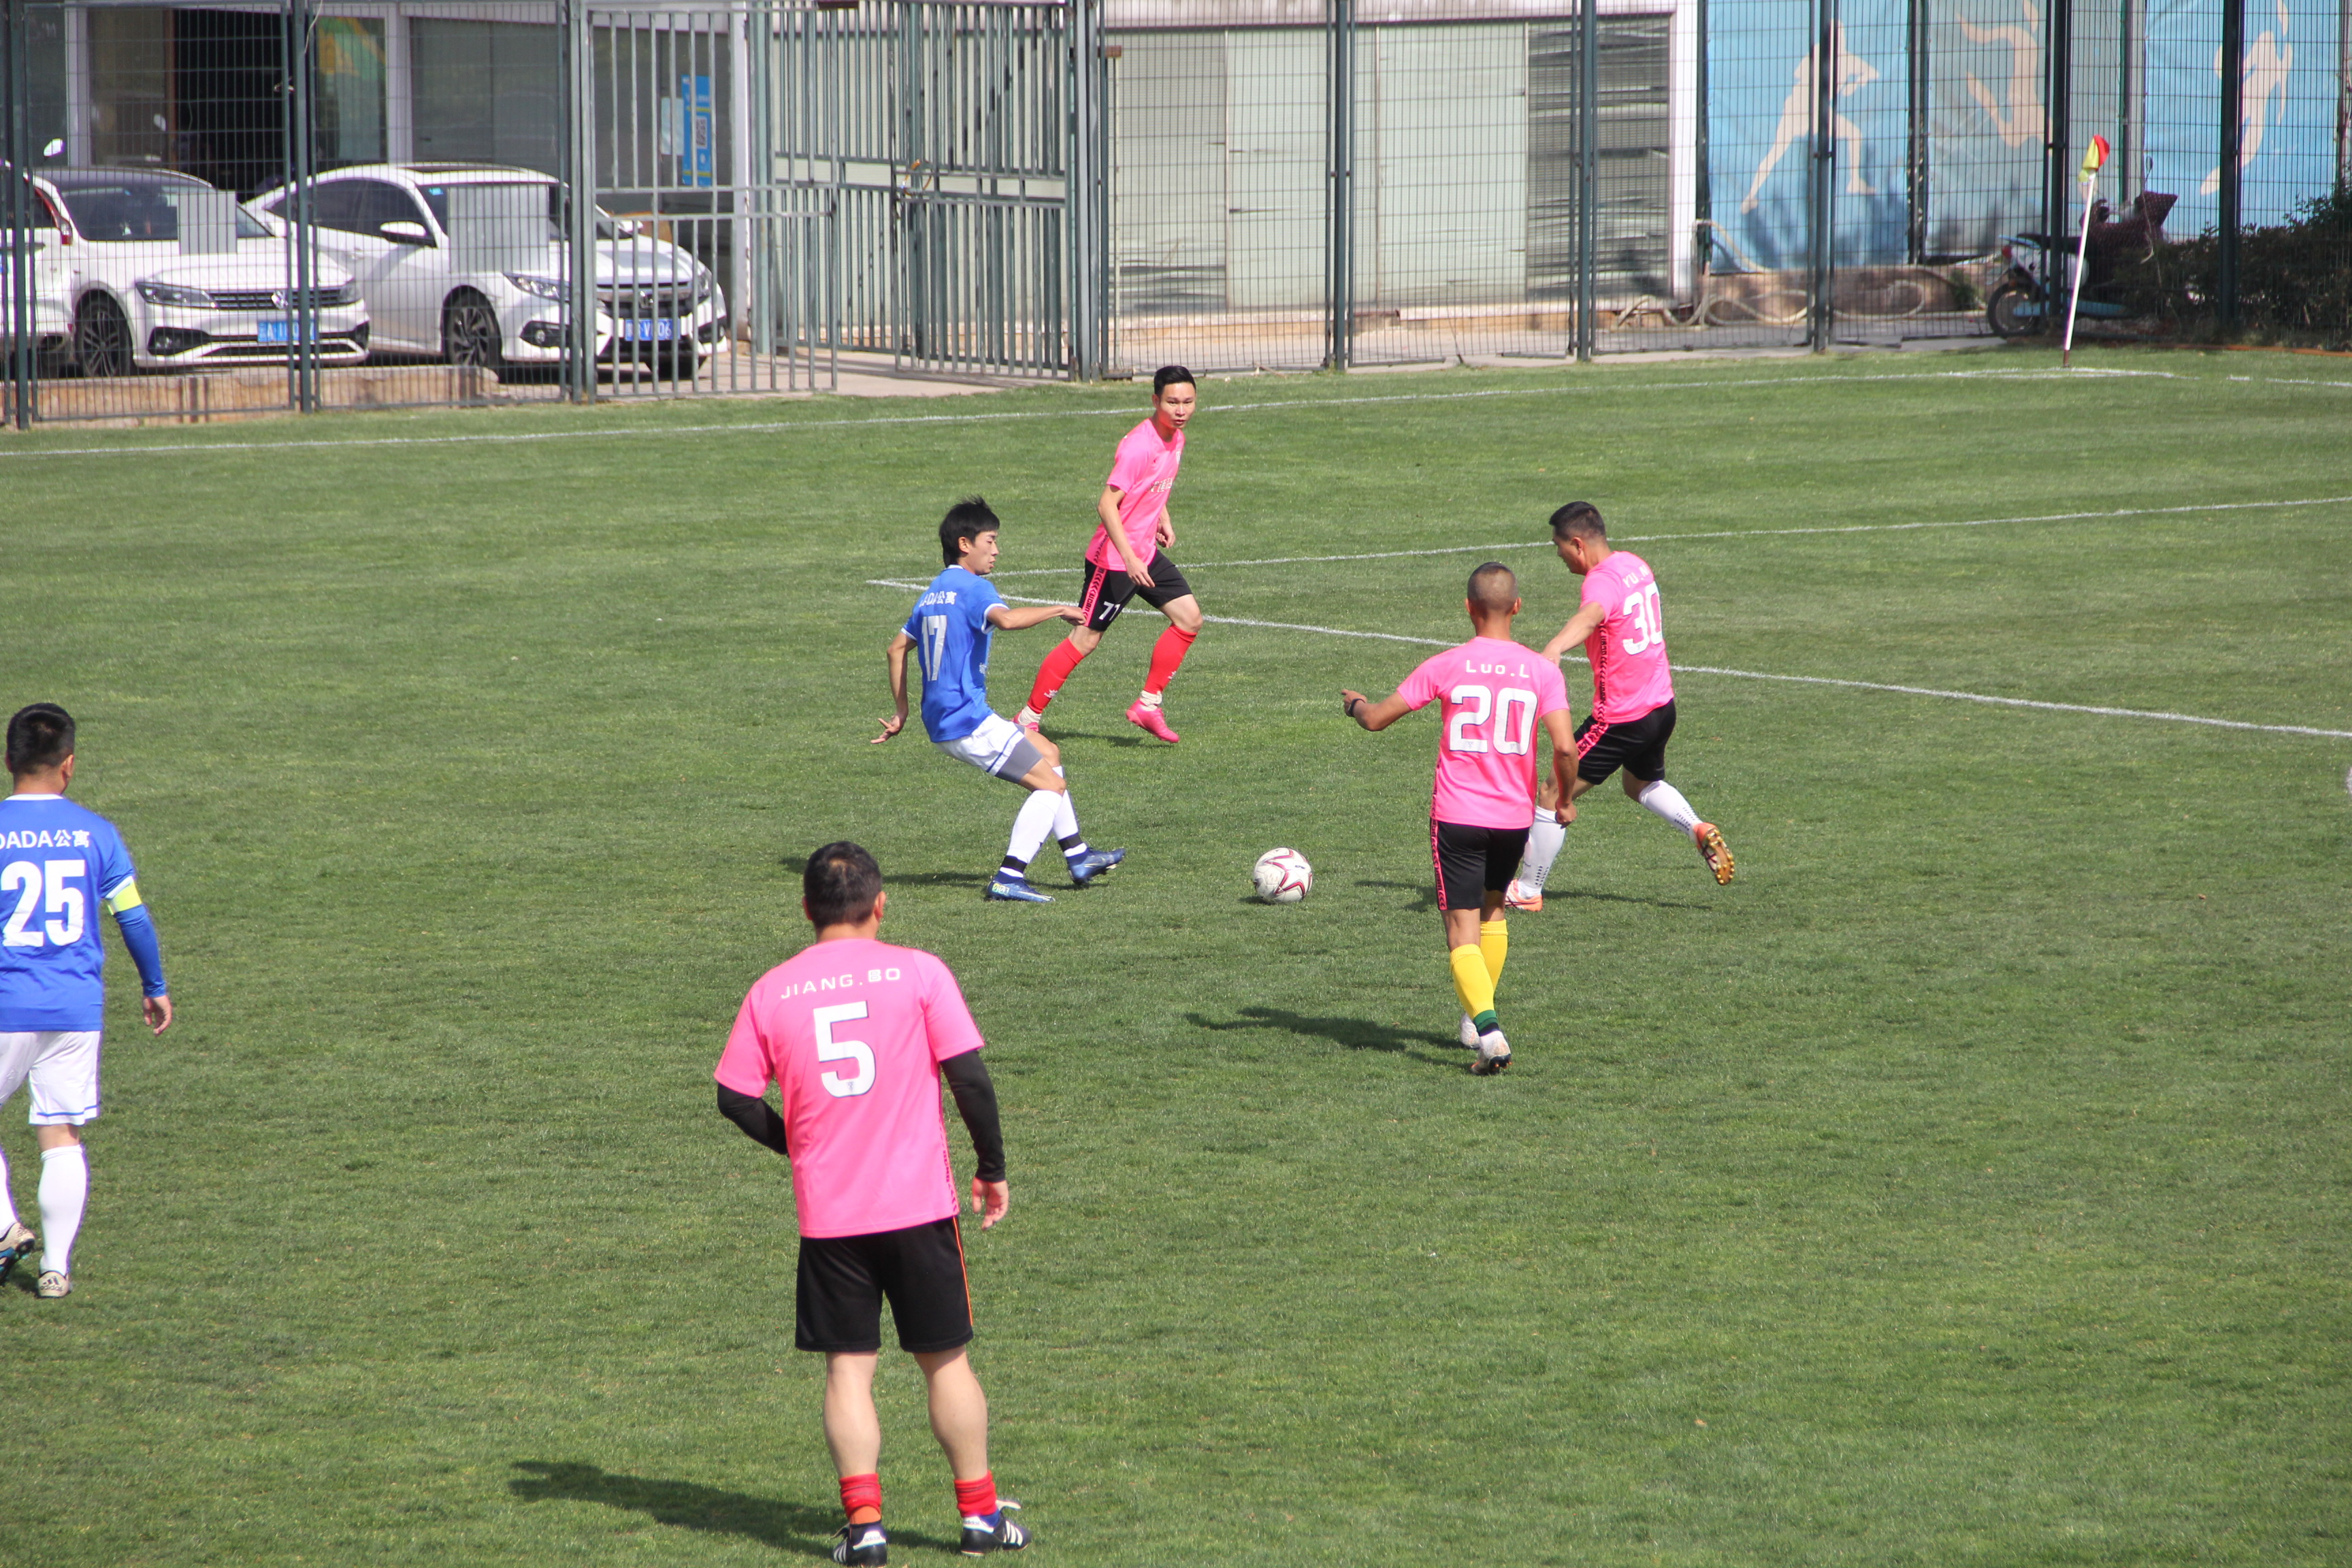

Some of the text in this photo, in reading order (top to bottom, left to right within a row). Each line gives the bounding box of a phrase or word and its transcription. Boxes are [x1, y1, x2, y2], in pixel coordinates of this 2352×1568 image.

[1098, 601, 1120, 621] 71
[1622, 581, 1663, 655] 30
[921, 615, 947, 681] 17
[1450, 685, 1538, 755] 20
[1, 860, 85, 947] 25
[781, 968, 900, 999] JIANG.BO
[813, 1000, 876, 1098] 5
